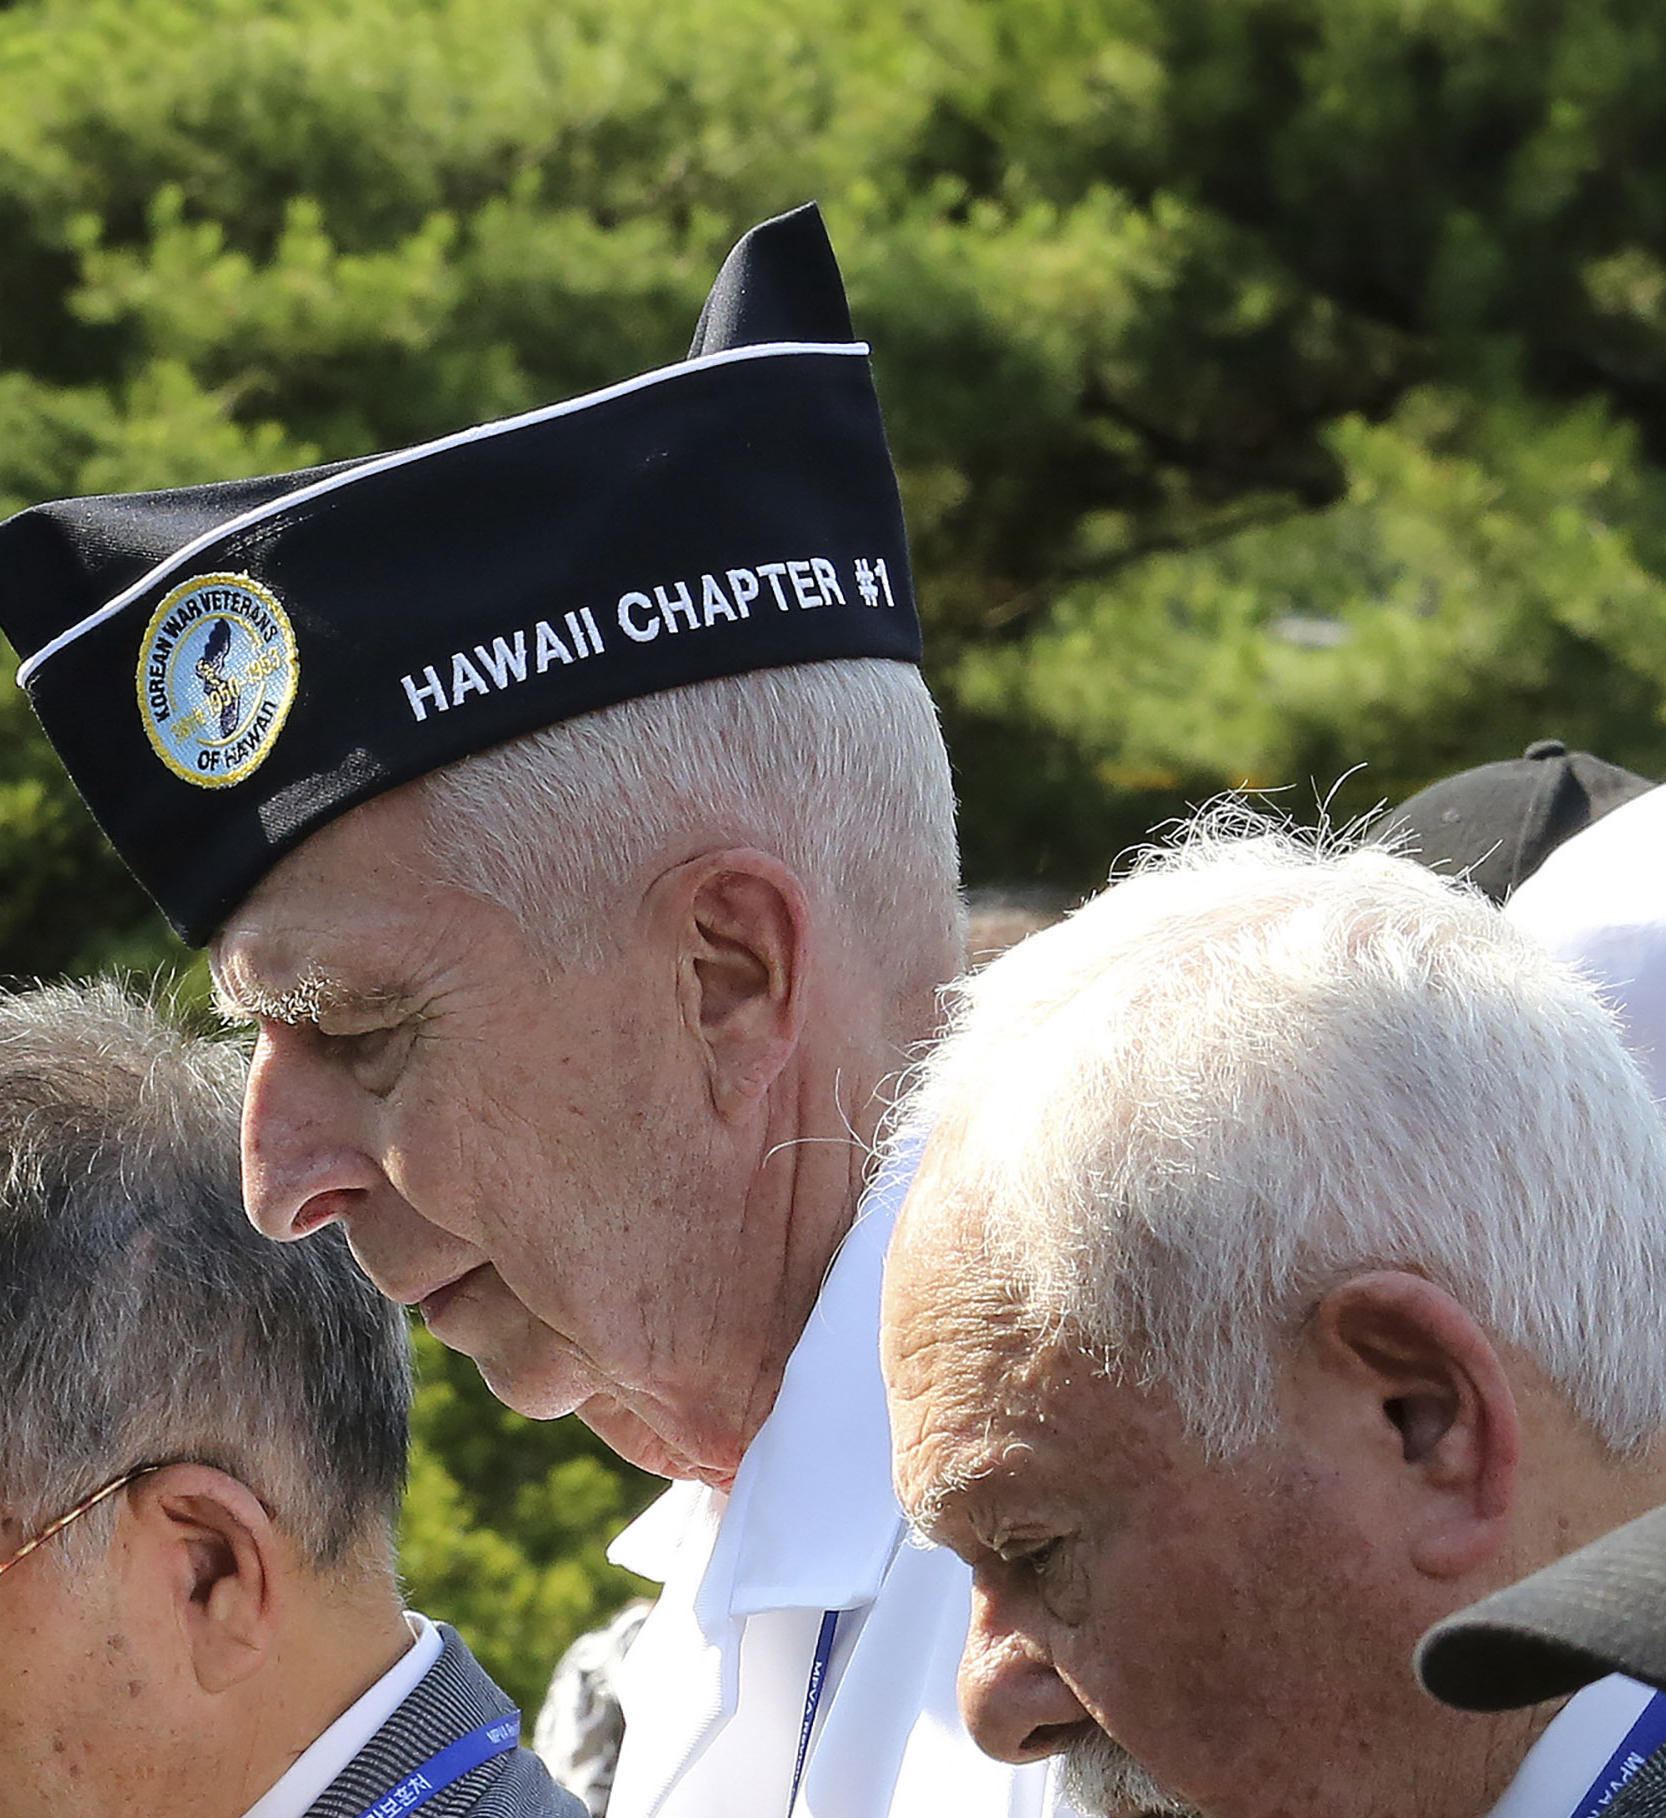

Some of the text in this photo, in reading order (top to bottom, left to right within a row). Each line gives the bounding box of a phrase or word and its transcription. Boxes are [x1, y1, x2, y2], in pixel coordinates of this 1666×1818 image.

[149, 590, 278, 722] KOREAN WAR VETERANS
[400, 556, 895, 721] HAWAII CHAPTER #1
[197, 750, 221, 771] OF
